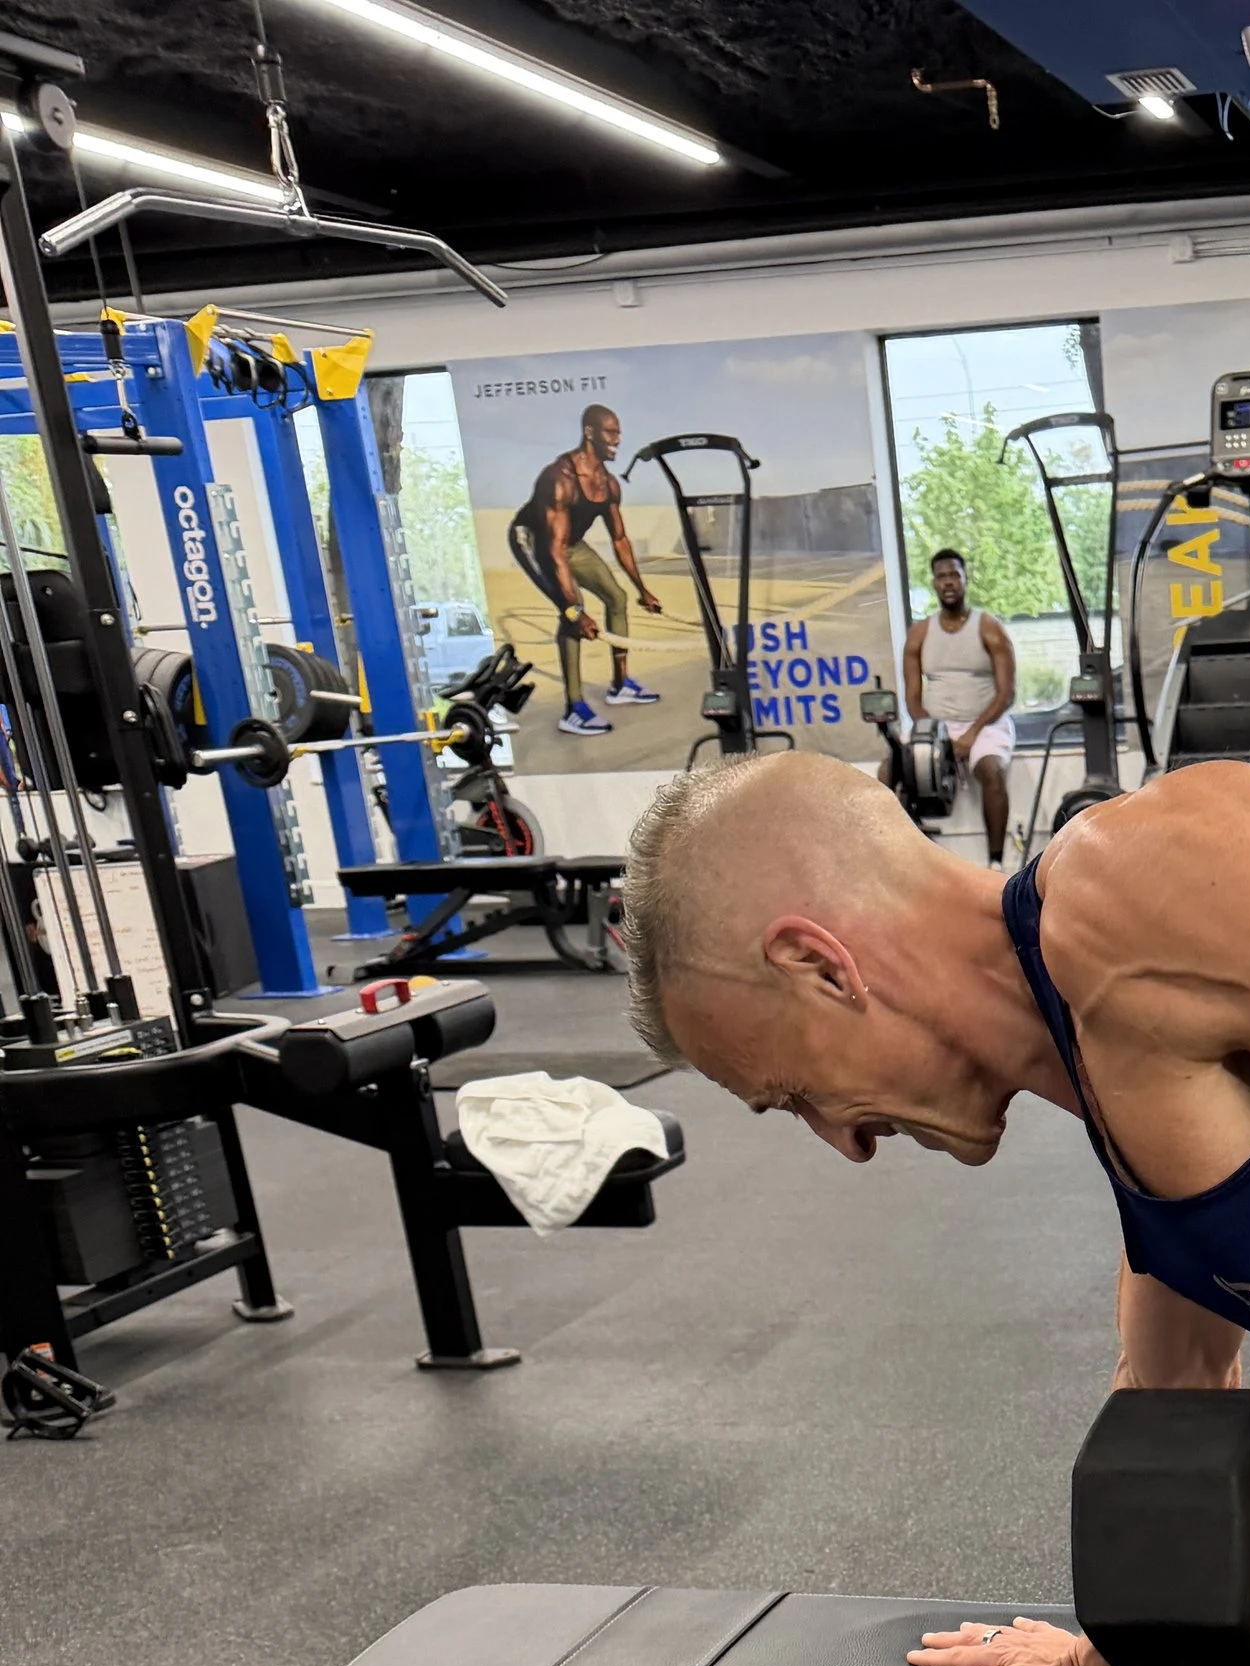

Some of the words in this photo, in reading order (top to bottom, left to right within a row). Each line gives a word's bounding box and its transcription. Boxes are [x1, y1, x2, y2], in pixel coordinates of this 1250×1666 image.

[474, 379, 575, 398] JEFFERSON
[580, 376, 607, 391] FIT
[724, 620, 808, 652] USH
[747, 655, 869, 690] EYOND
[752, 693, 842, 728] MITS
